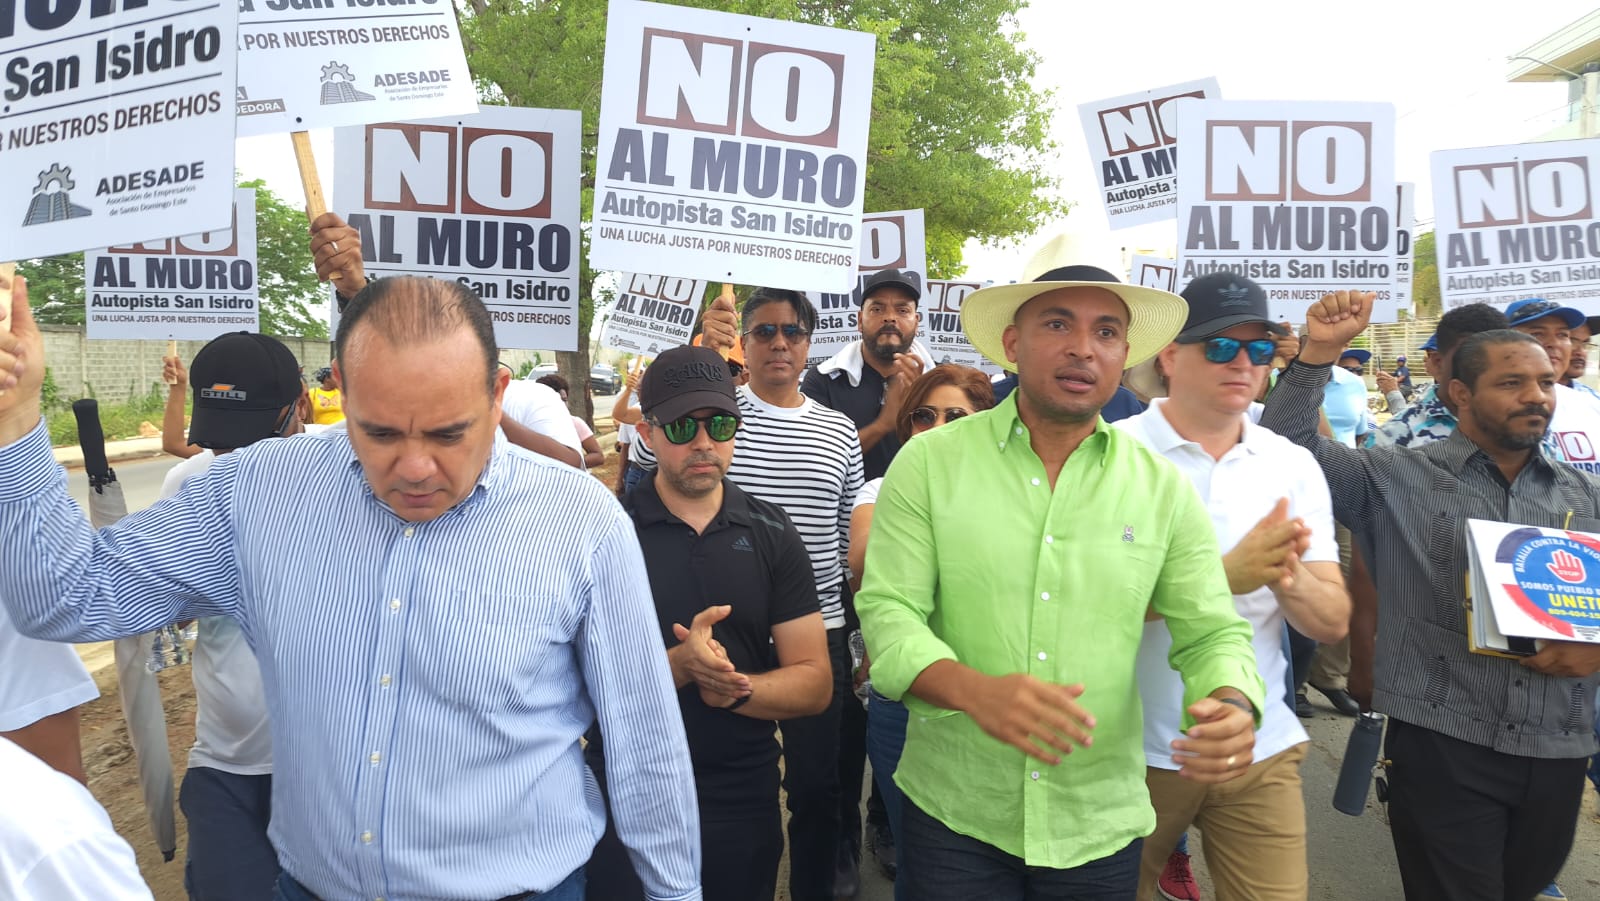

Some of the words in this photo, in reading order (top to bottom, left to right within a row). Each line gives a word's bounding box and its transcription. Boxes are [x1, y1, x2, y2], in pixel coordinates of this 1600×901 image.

[243, 33, 280, 50] POR
[283, 28, 369, 48] NUESTROS
[371, 24, 450, 43] DERECHOS
[4, 55, 80, 101] San
[95, 24, 220, 83] Isidro
[374, 70, 451, 87] ADESADE
[644, 34, 837, 137] NO
[8, 112, 109, 150] NUESTROS
[114, 91, 221, 130] DERECHOS
[371, 128, 546, 211] NO
[607, 127, 675, 187] AL
[690, 137, 857, 208] MURO
[1102, 157, 1139, 187] AL
[1211, 125, 1366, 196] NO
[96, 161, 204, 197] ADESADE
[143, 191, 153, 200] de
[153, 185, 196, 198] Empresarios
[1107, 182, 1171, 203] Autopista
[1458, 162, 1588, 223] NO
[109, 208, 119, 216] de
[120, 204, 139, 214] Santo
[140, 200, 171, 212] Domingo
[601, 191, 722, 226] Autopista
[730, 205, 776, 233] San
[785, 211, 853, 241] Isidro
[1124, 203, 1146, 213] LUCHA
[1146, 200, 1166, 209] JUSTA
[1185, 205, 1240, 250] AL
[1252, 206, 1389, 251] MURO
[346, 213, 403, 264] AL
[417, 217, 571, 273] MURO
[600, 226, 625, 241] UNA
[627, 230, 666, 246] LUCHA
[669, 236, 705, 250] JUSTA
[708, 239, 731, 253] POR
[734, 243, 792, 260] NUESTROS
[794, 249, 852, 267] DERECHOS
[1446, 231, 1490, 269] AL
[93, 256, 136, 288] AL
[145, 257, 253, 291] MURO
[1287, 259, 1326, 279] San
[1332, 259, 1389, 279] Isidro
[1447, 271, 1525, 291] Autopista
[1531, 269, 1562, 284] San
[92, 294, 169, 310] Autopista
[175, 295, 204, 308] San
[210, 296, 254, 309] Isidro
[506, 279, 571, 302] Isidro
[1270, 290, 1288, 300] POR
[1292, 290, 1337, 300] NUESTR
[110, 315, 134, 323] LUCHA
[178, 316, 216, 324] NUESTROS
[489, 311, 514, 322] TROS
[517, 312, 571, 325] DERECHOS
[615, 293, 637, 314] AL
[638, 298, 694, 327] MURO
[611, 313, 647, 329] Autopista
[649, 322, 664, 332] San
[665, 326, 689, 338] Isidro
[929, 313, 962, 332] MU
[814, 336, 835, 344] JUSTA
[836, 335, 850, 343] POR
[938, 335, 953, 343] San
[202, 390, 244, 400] STILL
[1531, 538, 1566, 548] CONTRA
[1569, 541, 1581, 550] LA
[1520, 581, 1555, 591] SOMOS
[1557, 584, 1594, 595] PUEBLO
